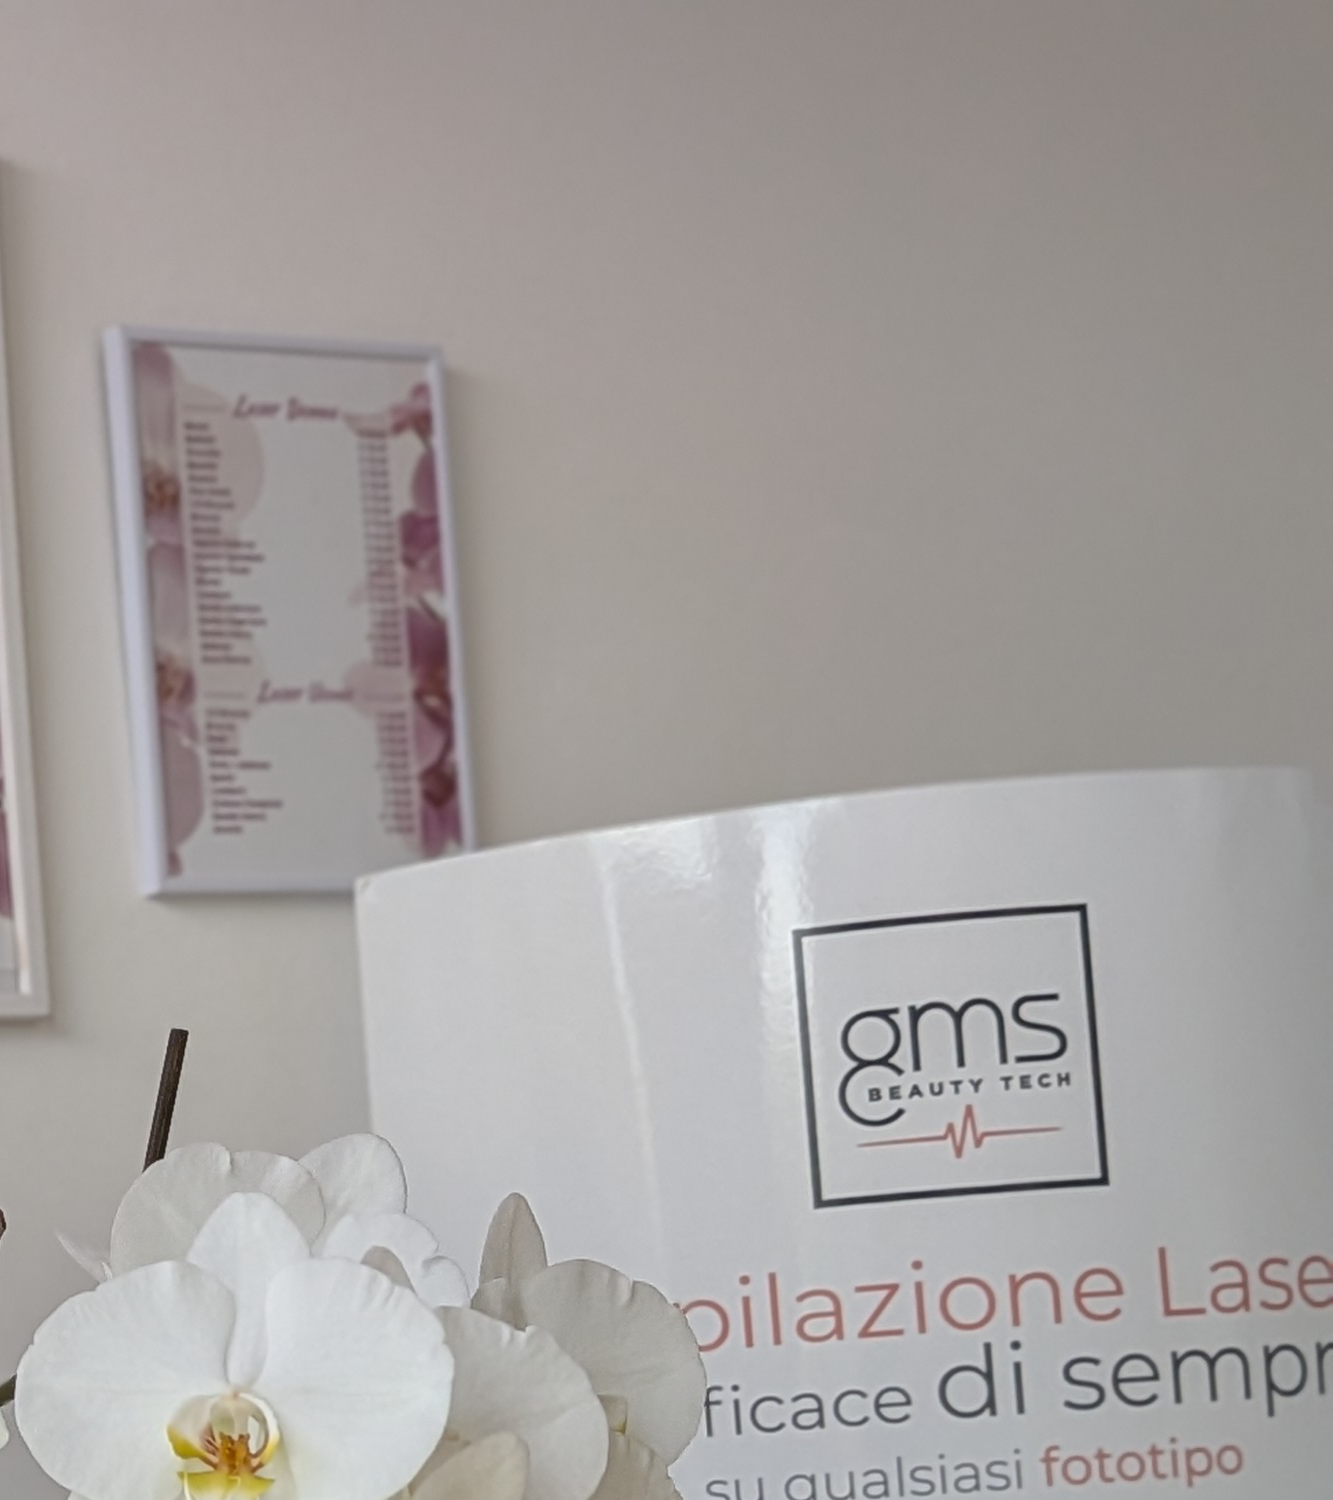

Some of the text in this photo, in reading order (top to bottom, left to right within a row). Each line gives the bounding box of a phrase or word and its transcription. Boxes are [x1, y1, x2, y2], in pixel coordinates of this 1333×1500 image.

[838, 992, 1069, 1128] gms
[867, 1072, 1072, 1103] BEAUTY TECH
[672, 1246, 1333, 1352] pilazione Lase
[703, 1339, 1333, 1438] ficace di sempr
[1039, 1436, 1244, 1488] fototipo
